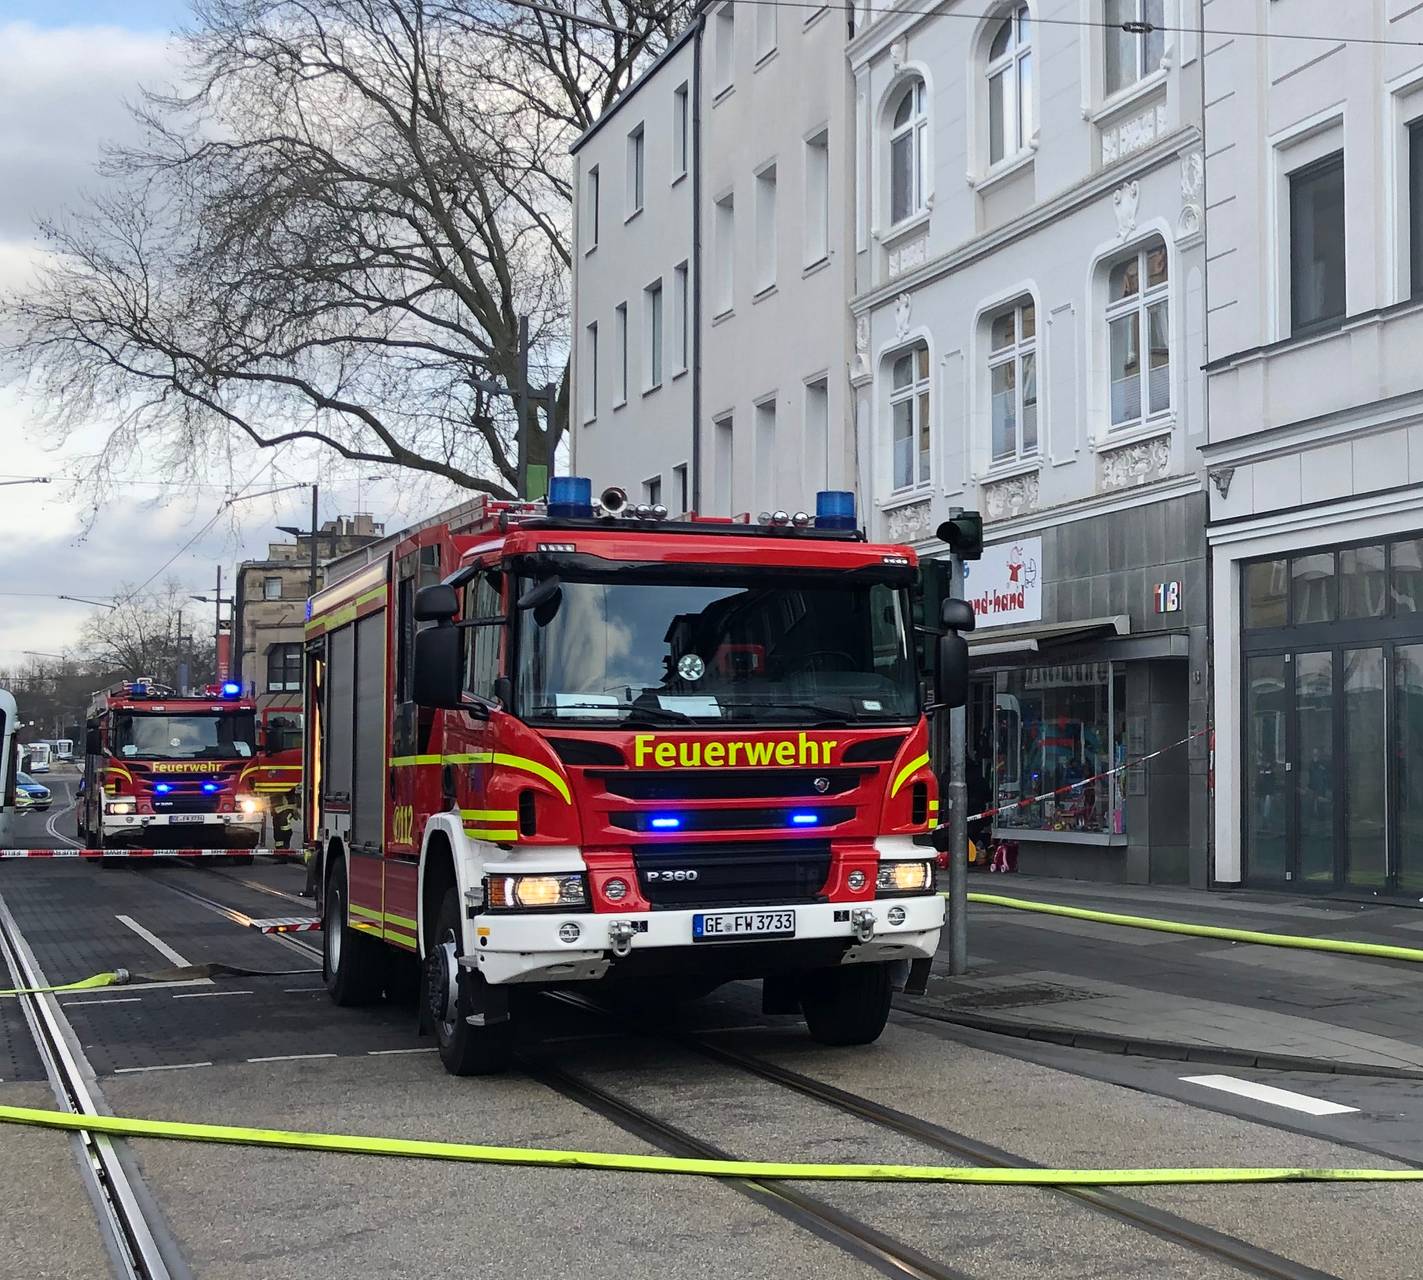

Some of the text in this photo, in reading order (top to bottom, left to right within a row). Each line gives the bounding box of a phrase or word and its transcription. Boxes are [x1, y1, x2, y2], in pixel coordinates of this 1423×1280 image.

[635, 733, 837, 767] Feuerwehr
[152, 761, 222, 773] Feuerwehr
[647, 870, 698, 882] P 360
[705, 917, 723, 932] GE
[735, 916, 753, 931] FW
[757, 914, 792, 930] 3733
